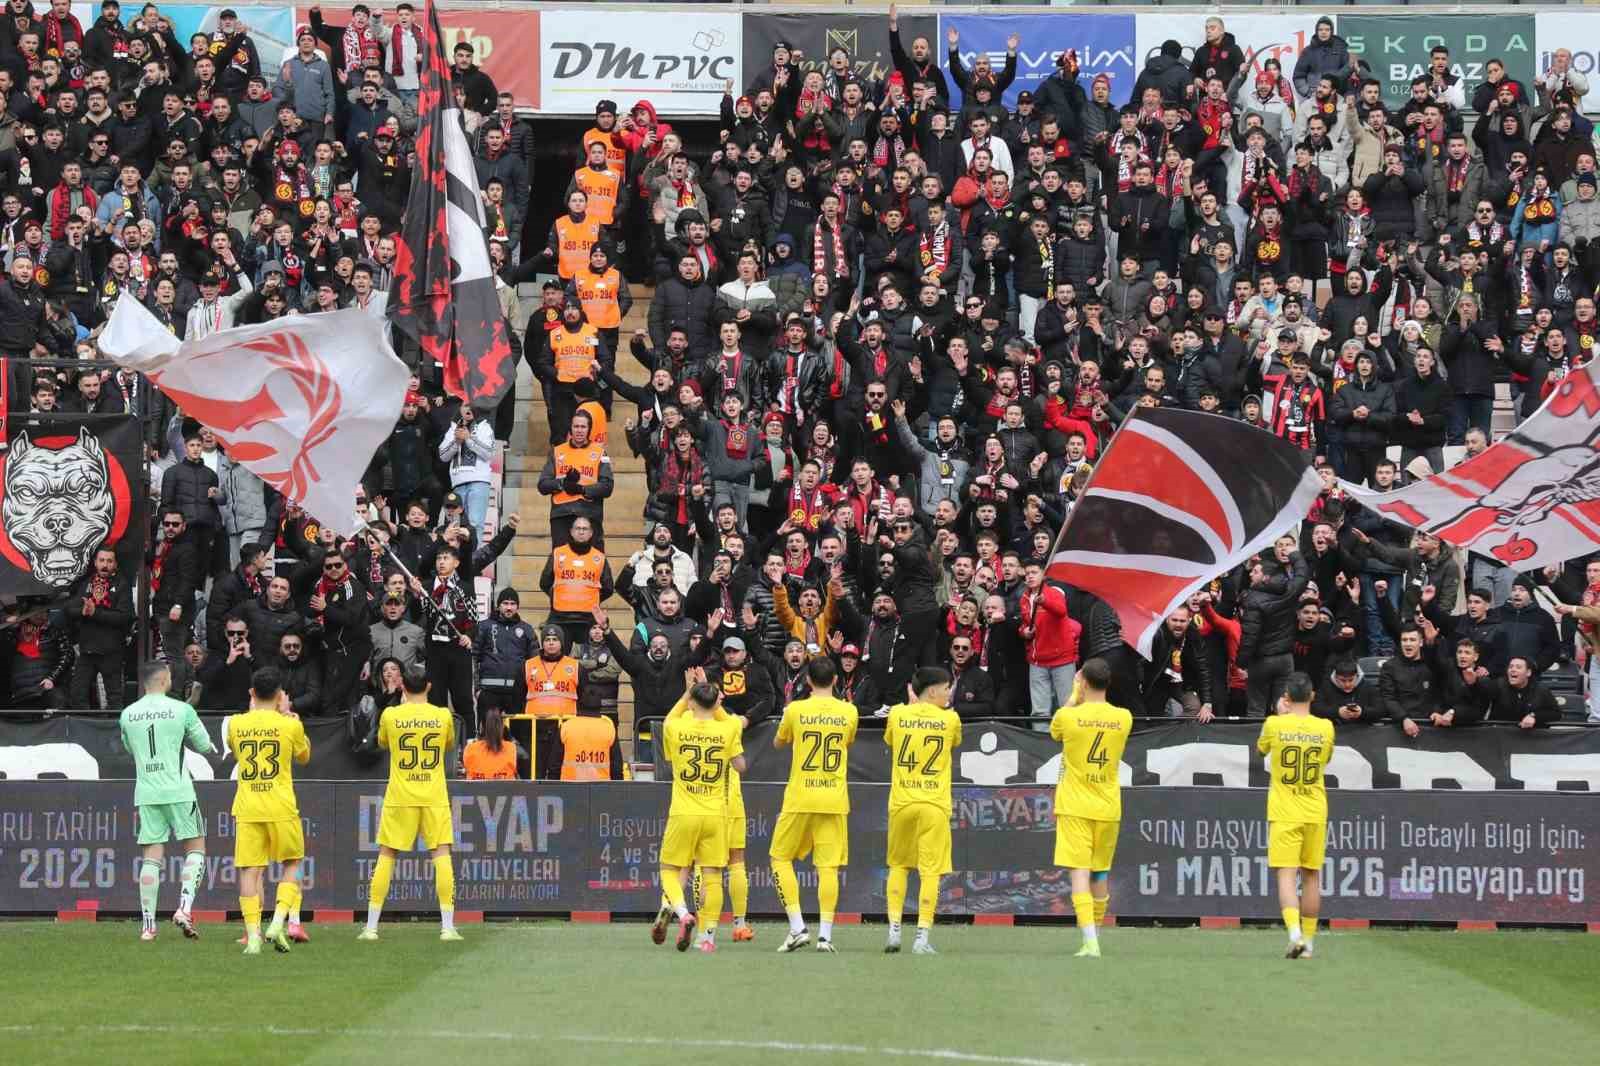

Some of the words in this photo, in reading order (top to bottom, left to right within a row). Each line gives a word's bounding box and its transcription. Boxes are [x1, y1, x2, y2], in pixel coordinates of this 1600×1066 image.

[146, 723, 157, 760] 1
[240, 740, 281, 780] 33
[399, 733, 440, 770] 55
[801, 731, 843, 772] 26
[897, 734, 944, 776] 42
[1087, 731, 1110, 770] 4
[679, 744, 723, 783] 35
[1281, 745, 1322, 784] 96
[42, 806, 117, 841] TARİHİ
[1400, 820, 1476, 852] Detaylı
[1485, 822, 1531, 854] Bilgi
[1540, 818, 1585, 855] İçin:
[19, 847, 115, 889] 2026
[1176, 856, 1270, 896] MART
[1400, 857, 1585, 903] deneyap.org
